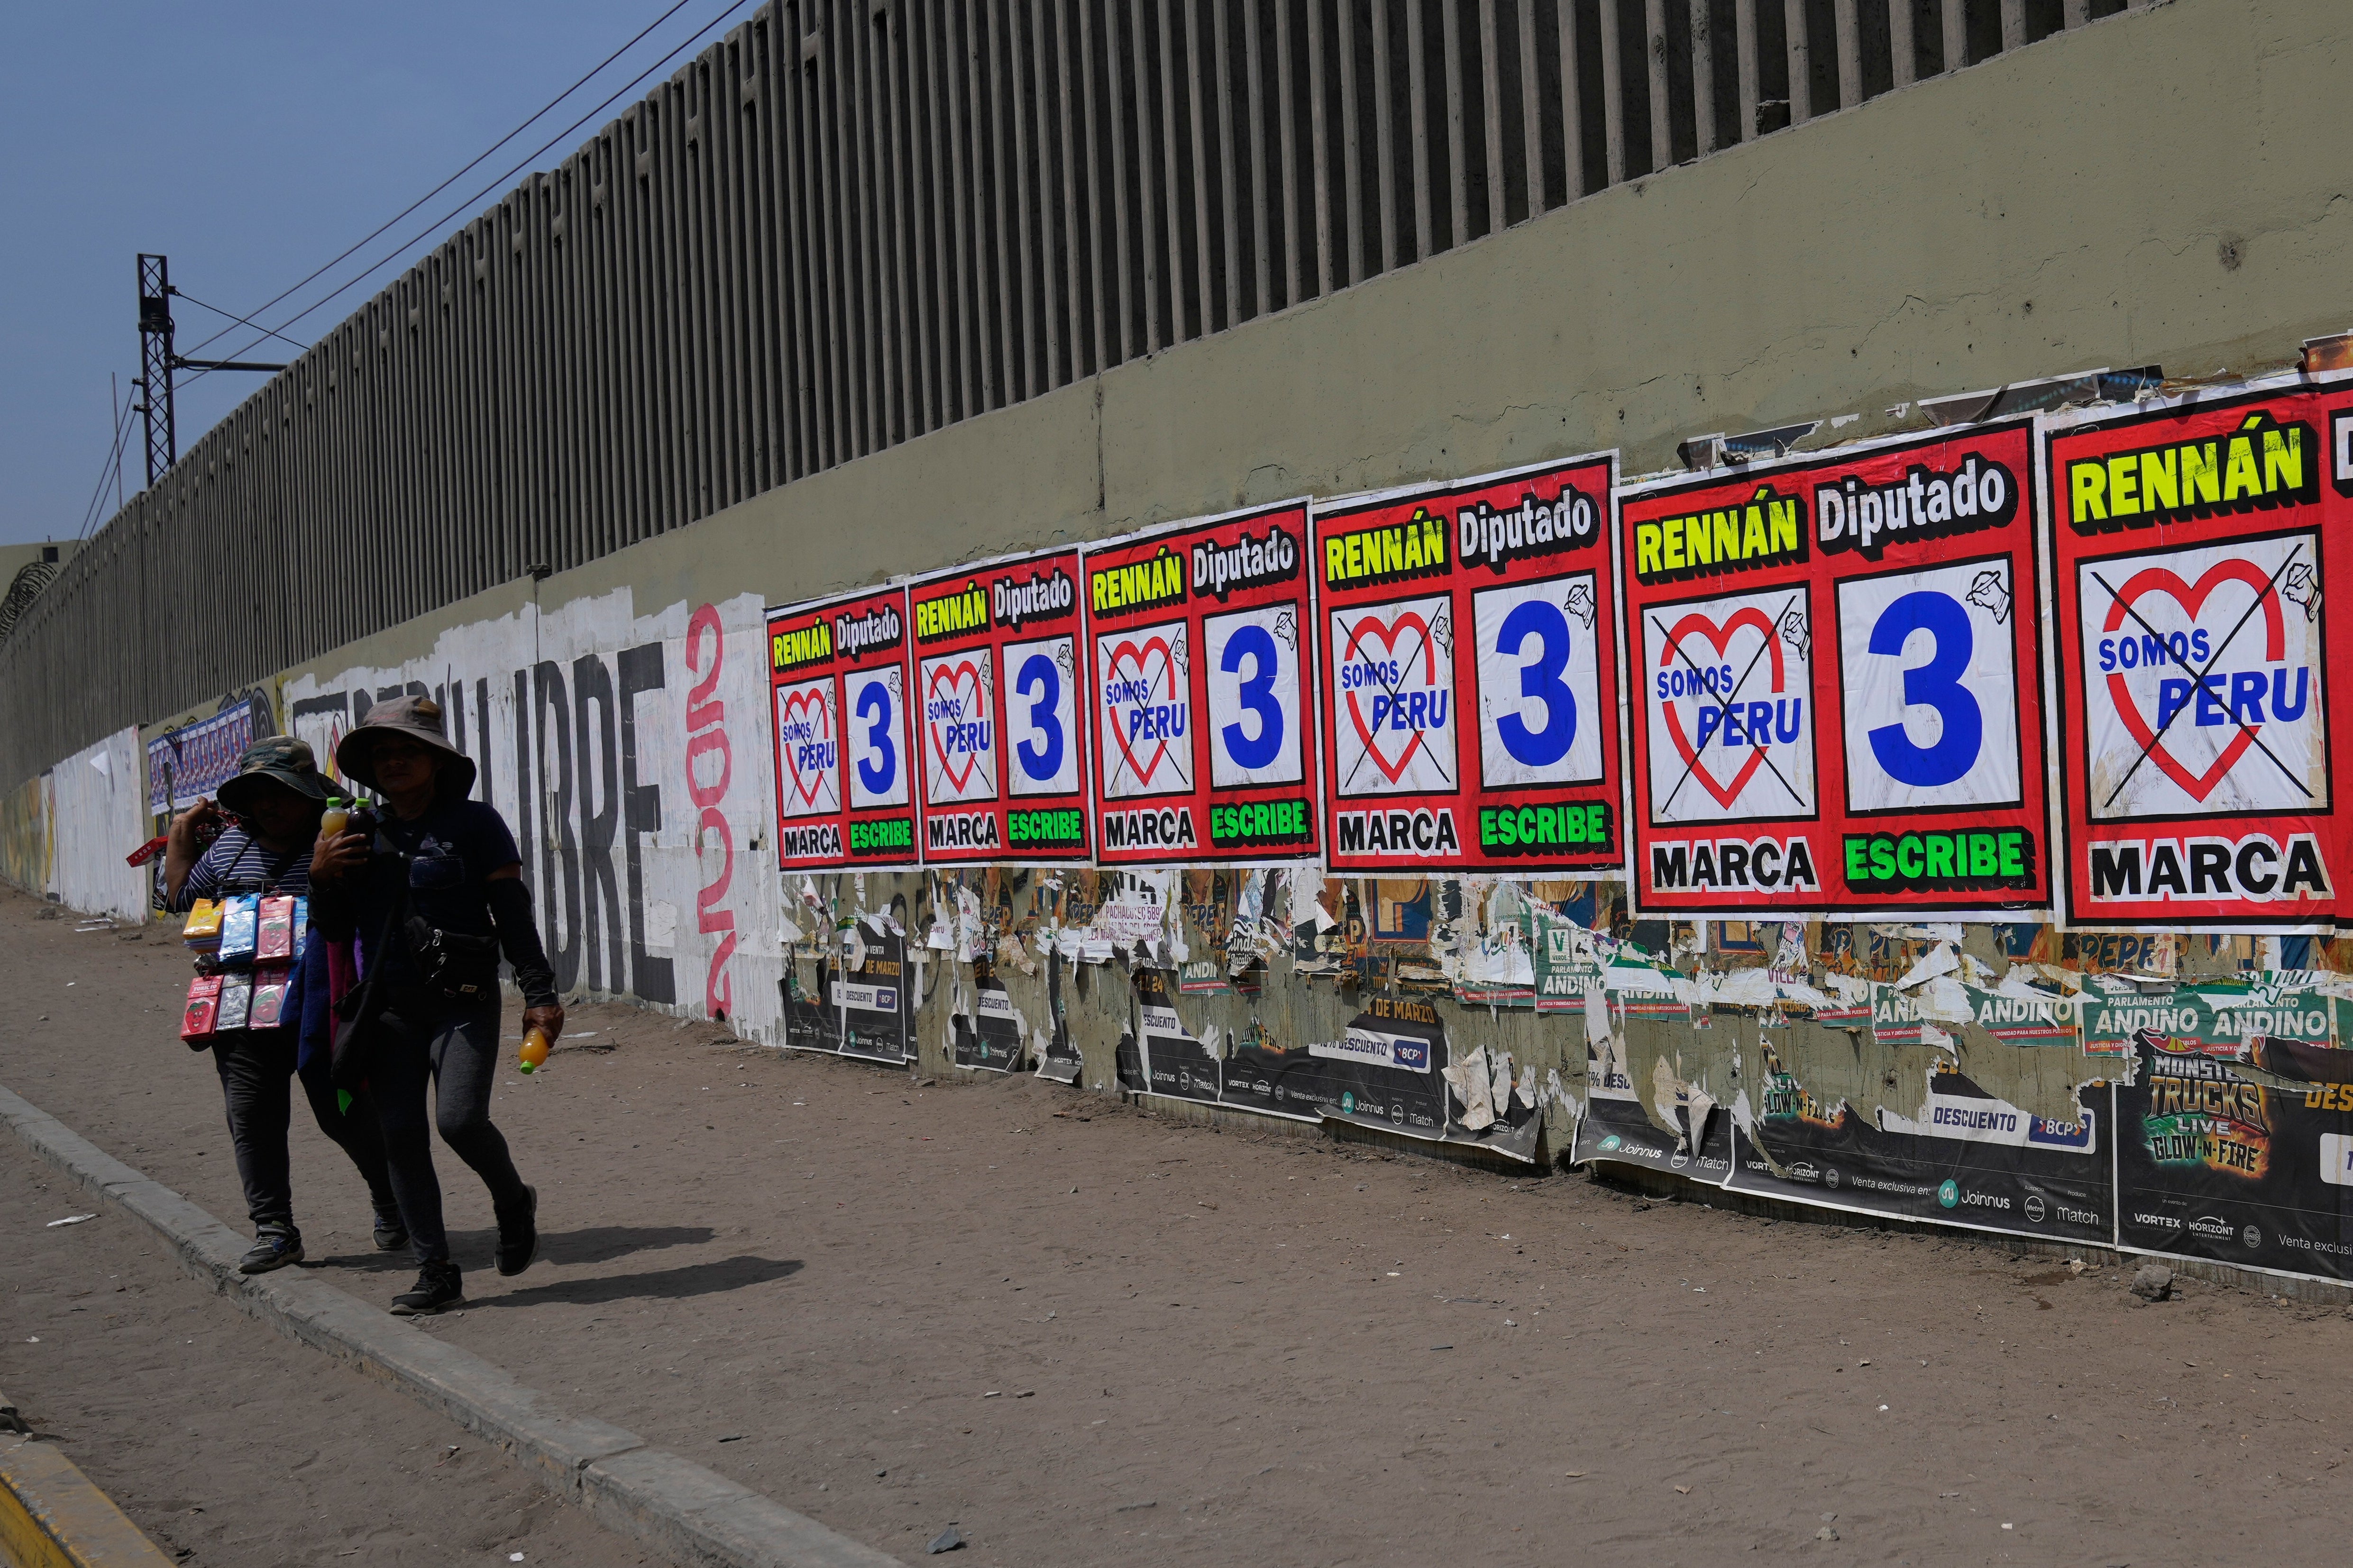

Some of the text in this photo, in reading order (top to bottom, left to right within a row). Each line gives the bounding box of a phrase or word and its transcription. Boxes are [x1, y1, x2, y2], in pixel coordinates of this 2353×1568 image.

[2072, 417, 2302, 522] RENNÁN
[1639, 460, 2005, 574] RENNÁN Diputado
[1328, 490, 1591, 581] RENNÁN Diputado
[1093, 530, 1293, 611] RENNÁN Diputado
[917, 572, 1071, 636] RENNÁN Diputado
[774, 607, 899, 666] RENNÁN Diputado
[2099, 629, 2209, 671] SOMOS
[1342, 660, 1399, 689] SOMOS
[1496, 601, 1576, 766] 3
[1657, 665, 1733, 699] SOMOS
[1868, 592, 1982, 786] 3
[1106, 679, 1148, 705] SOMOS
[1221, 626, 1283, 769] 3
[2158, 667, 2308, 730] PERU
[928, 698, 961, 720] SOMOS
[1016, 655, 1063, 781] 3
[1130, 703, 1185, 742] PERU
[1373, 690, 1447, 731] PERU
[1697, 698, 1801, 748] PERU
[783, 722, 810, 743] SOMOS
[856, 682, 896, 794] 3
[946, 721, 990, 755] PERU
[799, 741, 835, 772] PERU
[785, 820, 911, 857] MARCA ESCRIBE
[929, 811, 1080, 848] MARCA ESCRIBE
[1105, 802, 1307, 847] MARCA ESCRIBE
[1339, 806, 1605, 851] MARCA ESCRIBE
[1654, 833, 2024, 889] MARCA ESCRIBE
[2090, 833, 2326, 896] MARCA
[870, 945, 884, 955] VENTA
[866, 960, 900, 976] DE MARZO
[846, 991, 872, 1003] DESCUENTO
[1543, 975, 1607, 995] ANDINO
[1376, 998, 1436, 1024] DE MARZO
[1978, 999, 2073, 1023] ANDINO
[2107, 995, 2174, 1007] PARLAMENTO
[2094, 1007, 2198, 1034] ANDINO
[2212, 1010, 2327, 1037] ANDINO
[1401, 1047, 1419, 1061] BCP
[1152, 1070, 1176, 1083] Joinnus
[1291, 1091, 1305, 1100] Venta
[1355, 1100, 1384, 1115] Joinnus
[2147, 1076, 2269, 1133] TRUCKS
[1933, 1107, 2017, 1132] DESCUENTO
[2046, 1121, 2074, 1136] BCP
[2176, 1116, 2231, 1136] LIVE
[1619, 1143, 1663, 1158] Joinnus
[1673, 1154, 1688, 1162] Metro
[1852, 1176, 2011, 1209] Venta exclusiva en: Joinnus
[2026, 1204, 2043, 1213] Metro
[2188, 1221, 2234, 1236] HORIZONT
[2192, 1232, 2231, 1241] ENTERTAINMENT
[2278, 1234, 2311, 1249] Venta
